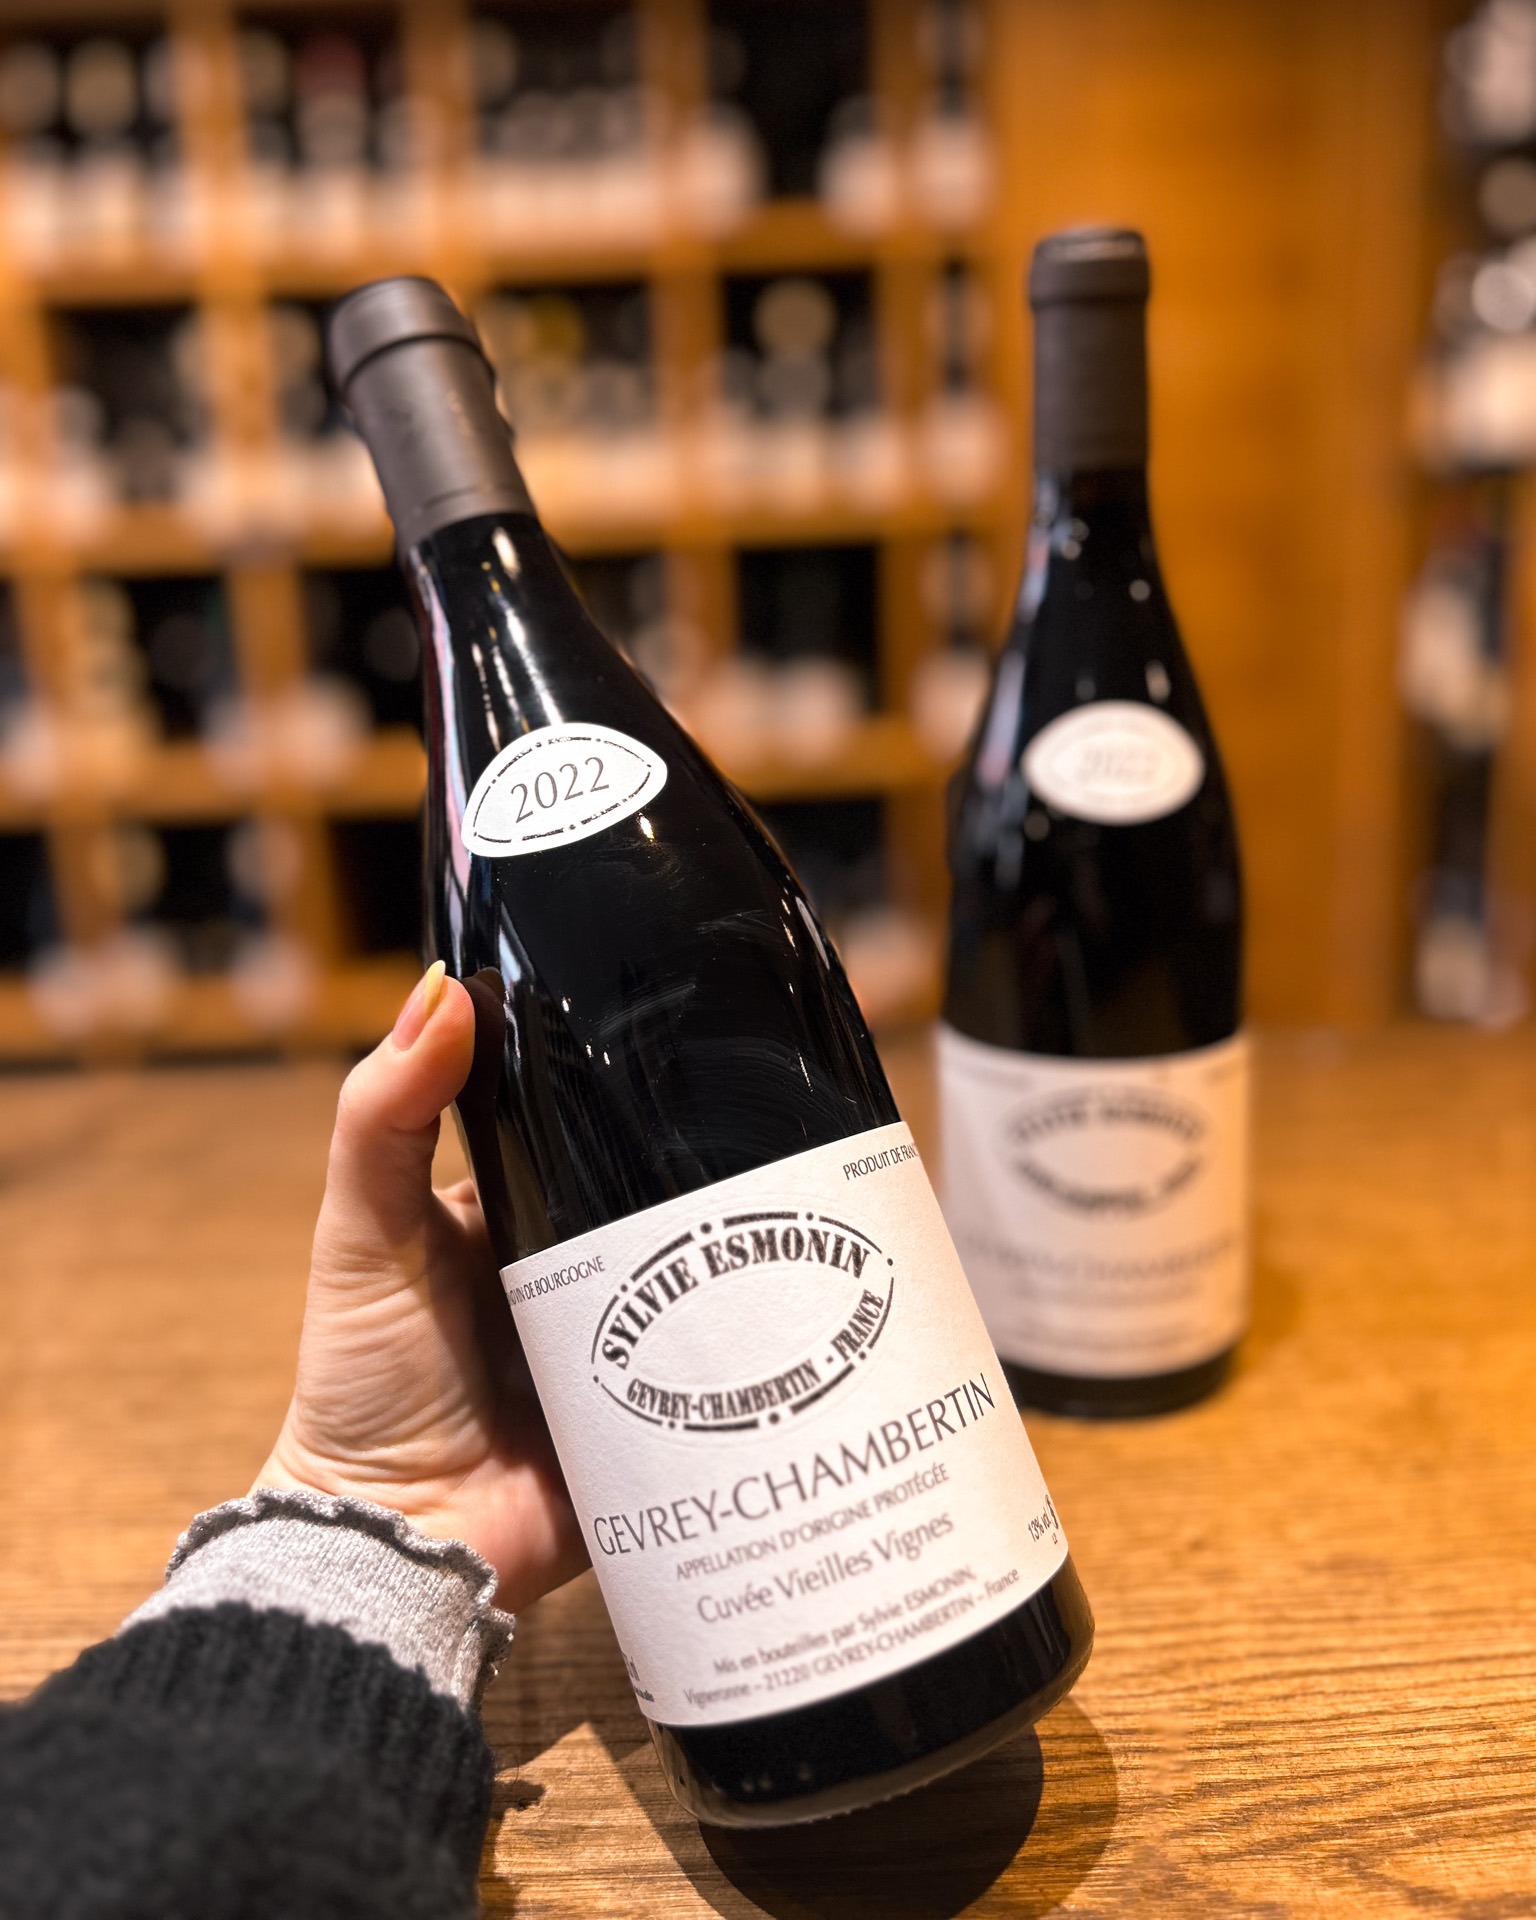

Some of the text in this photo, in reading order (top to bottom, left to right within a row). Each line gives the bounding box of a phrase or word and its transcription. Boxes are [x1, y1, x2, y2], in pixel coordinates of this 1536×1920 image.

[511, 756, 610, 824] 2022
[842, 1150, 891, 1181] PRODUIT
[889, 1146, 904, 1165] DE
[524, 1281, 536, 1300] DE
[534, 1255, 606, 1296] BOURGOGNE
[601, 1257, 700, 1370] SYLVIE
[700, 1226, 871, 1279] ESMONIN
[626, 1358, 822, 1422] GEVREY-CHAMBERTIN
[829, 1288, 885, 1363] FRANCE
[592, 1372, 996, 1556] GEVREY-CHAMBERTIN
[675, 1461, 951, 1582] APPELLATION D'ORIGINE PROTÉGÉE
[696, 1510, 956, 1625] Cuvée Vieilles Vignes
[713, 1655, 738, 1676] Mis
[739, 1652, 758, 1671] en
[830, 1621, 858, 1648] par
[857, 1599, 904, 1634] Sylvie
[811, 1596, 976, 1677] GEVREY-CHAMBERTIN
[984, 1567, 1022, 1602] France
